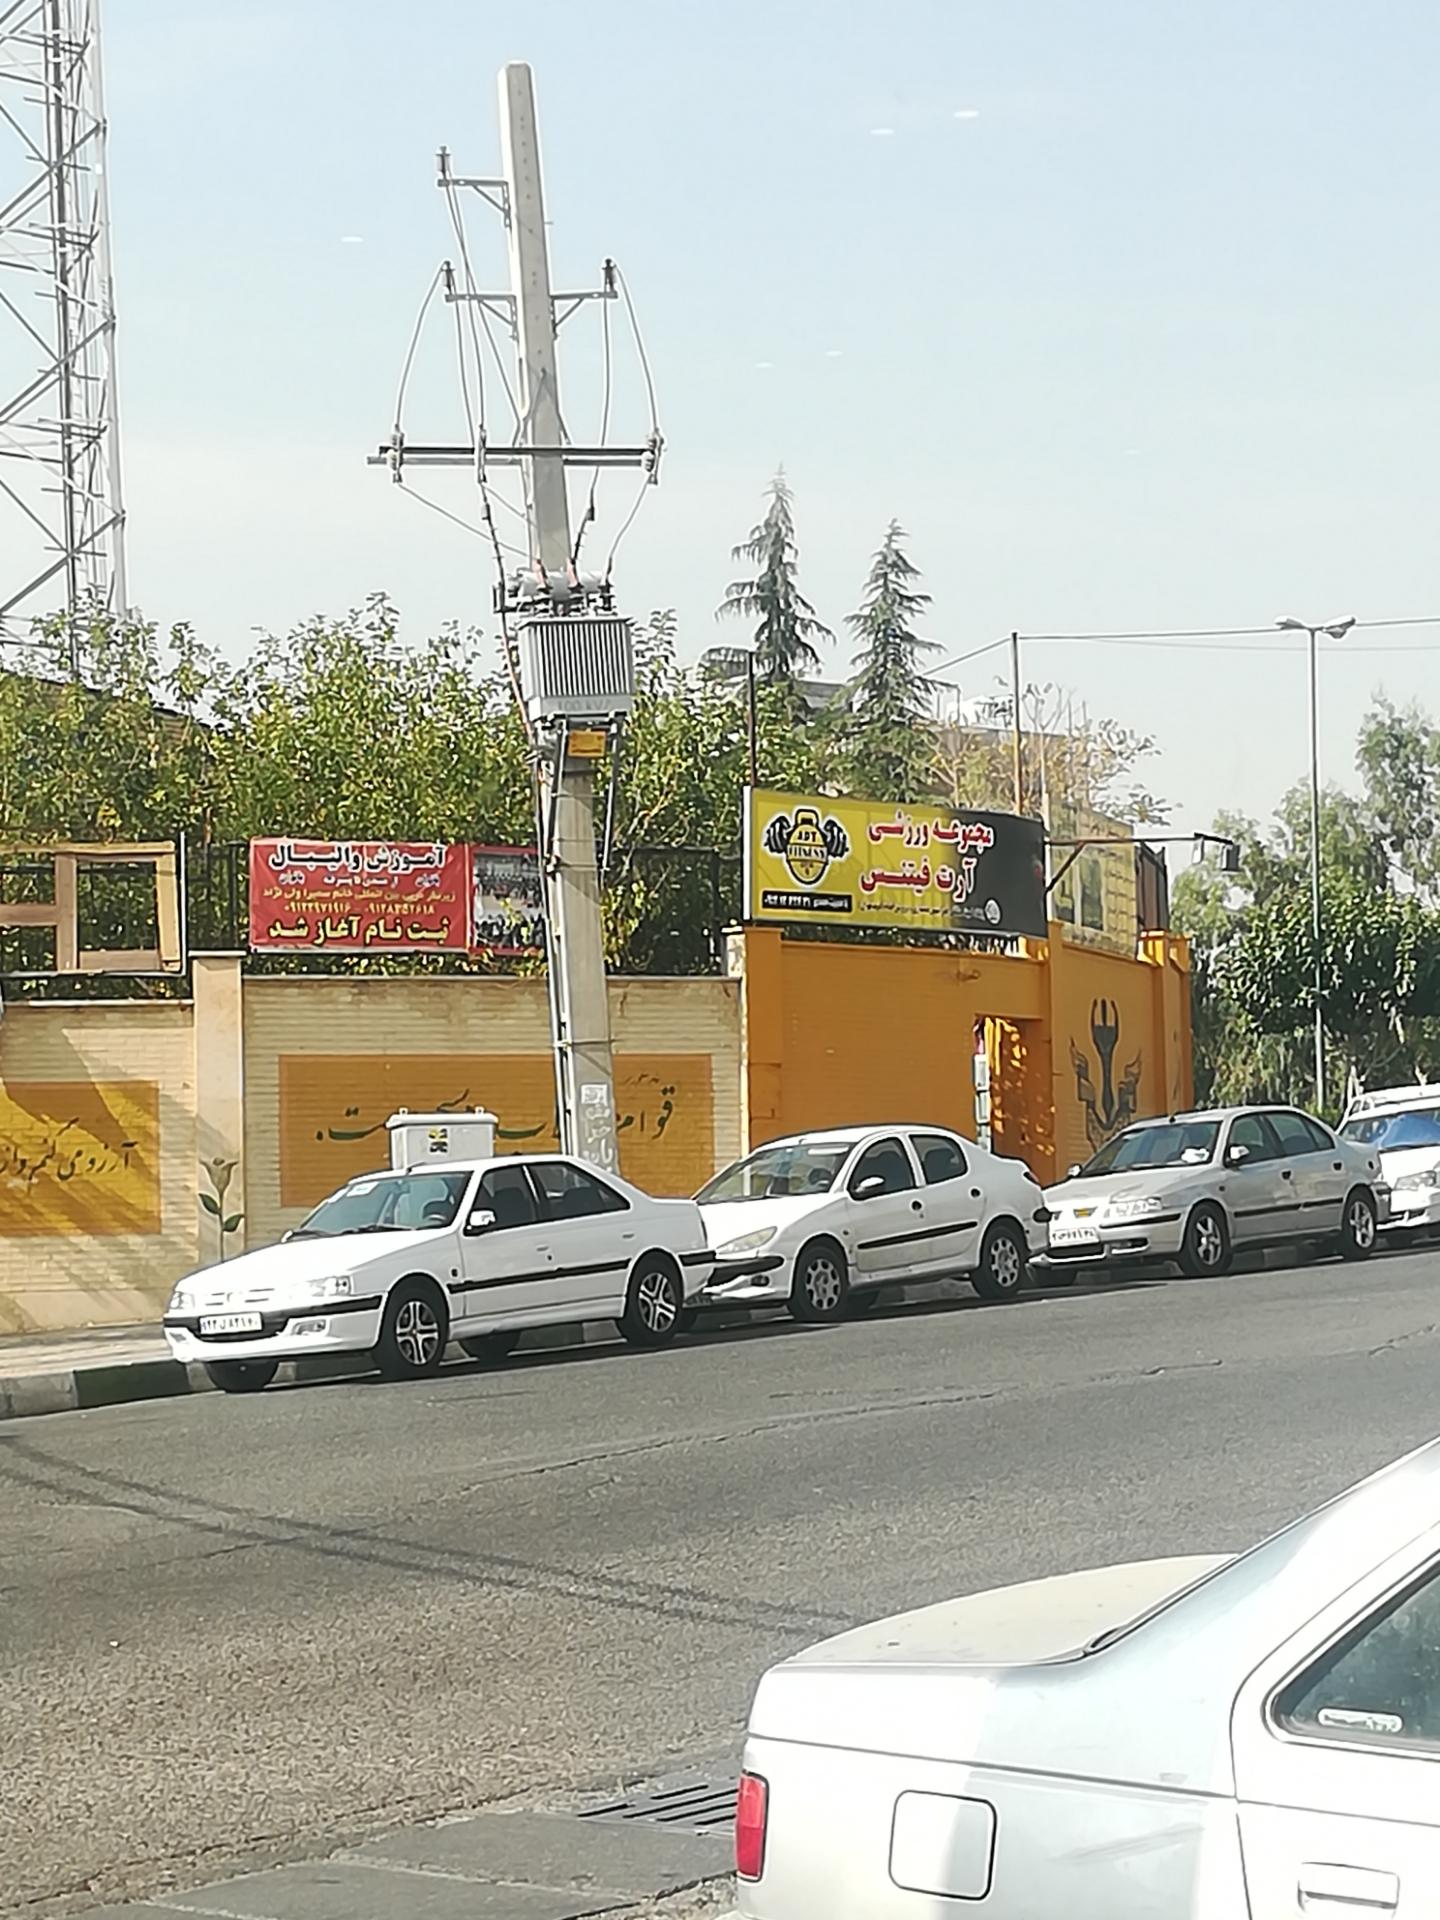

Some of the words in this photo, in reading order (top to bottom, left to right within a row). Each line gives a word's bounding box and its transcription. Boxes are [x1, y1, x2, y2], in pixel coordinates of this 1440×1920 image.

[868, 810, 929, 848] ورزشی
[932, 817, 994, 853] مجموعه
[269, 843, 362, 870] والیبال
[364, 842, 447, 872] آموزش
[860, 856, 931, 894] فیتنس
[935, 857, 977, 901] آرت
[269, 917, 309, 939] شد
[315, 914, 361, 945] آغاز
[364, 916, 402, 944] نام
[407, 917, 450, 944] ثبت
